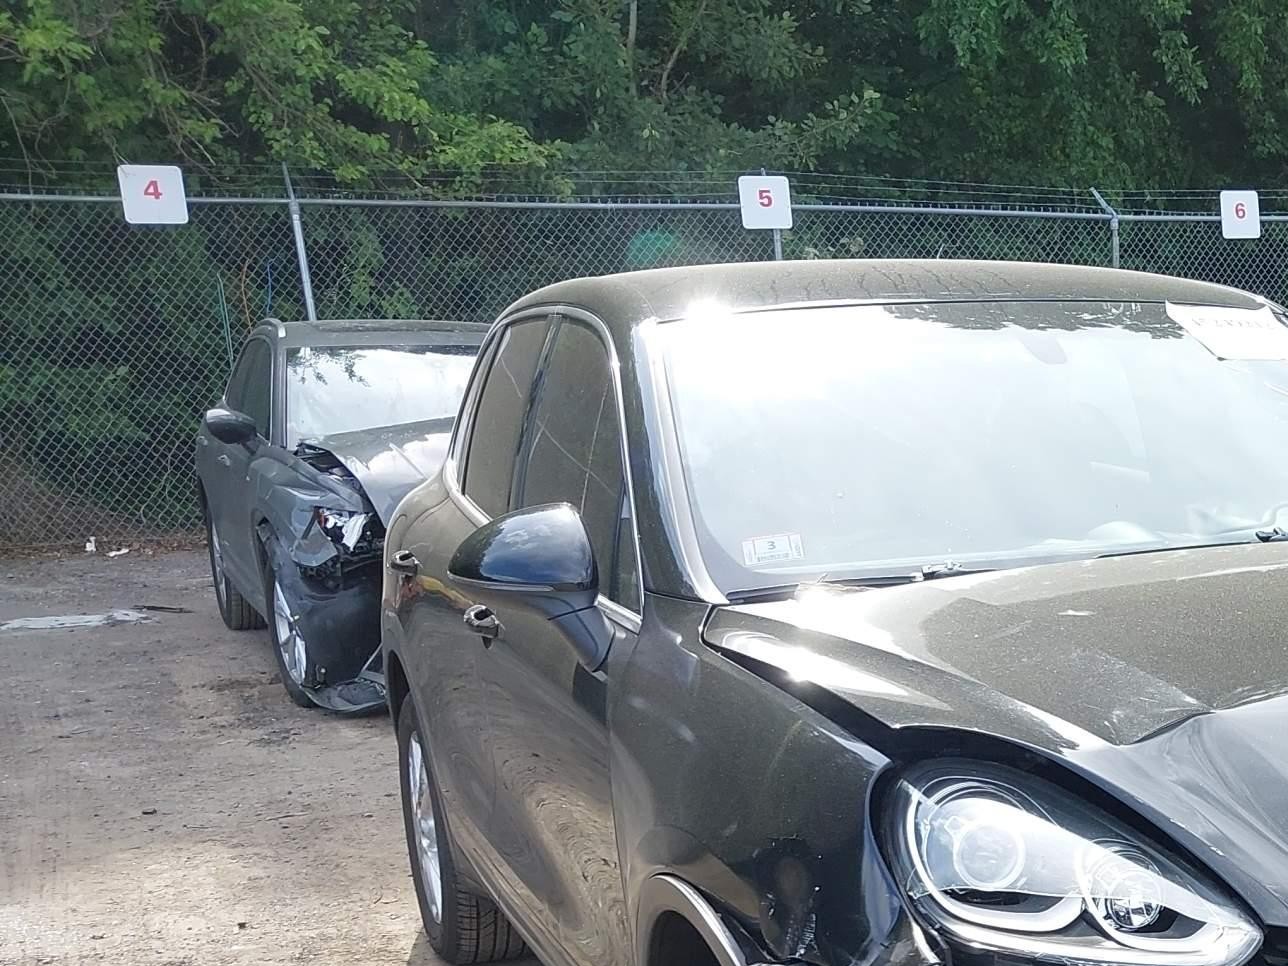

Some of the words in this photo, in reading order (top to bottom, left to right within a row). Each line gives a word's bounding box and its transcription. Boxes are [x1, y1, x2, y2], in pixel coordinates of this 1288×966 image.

[143, 180, 163, 200] 4
[758, 189, 773, 208] 5
[1234, 202, 1247, 220] 6
[767, 540, 777, 550] 3
